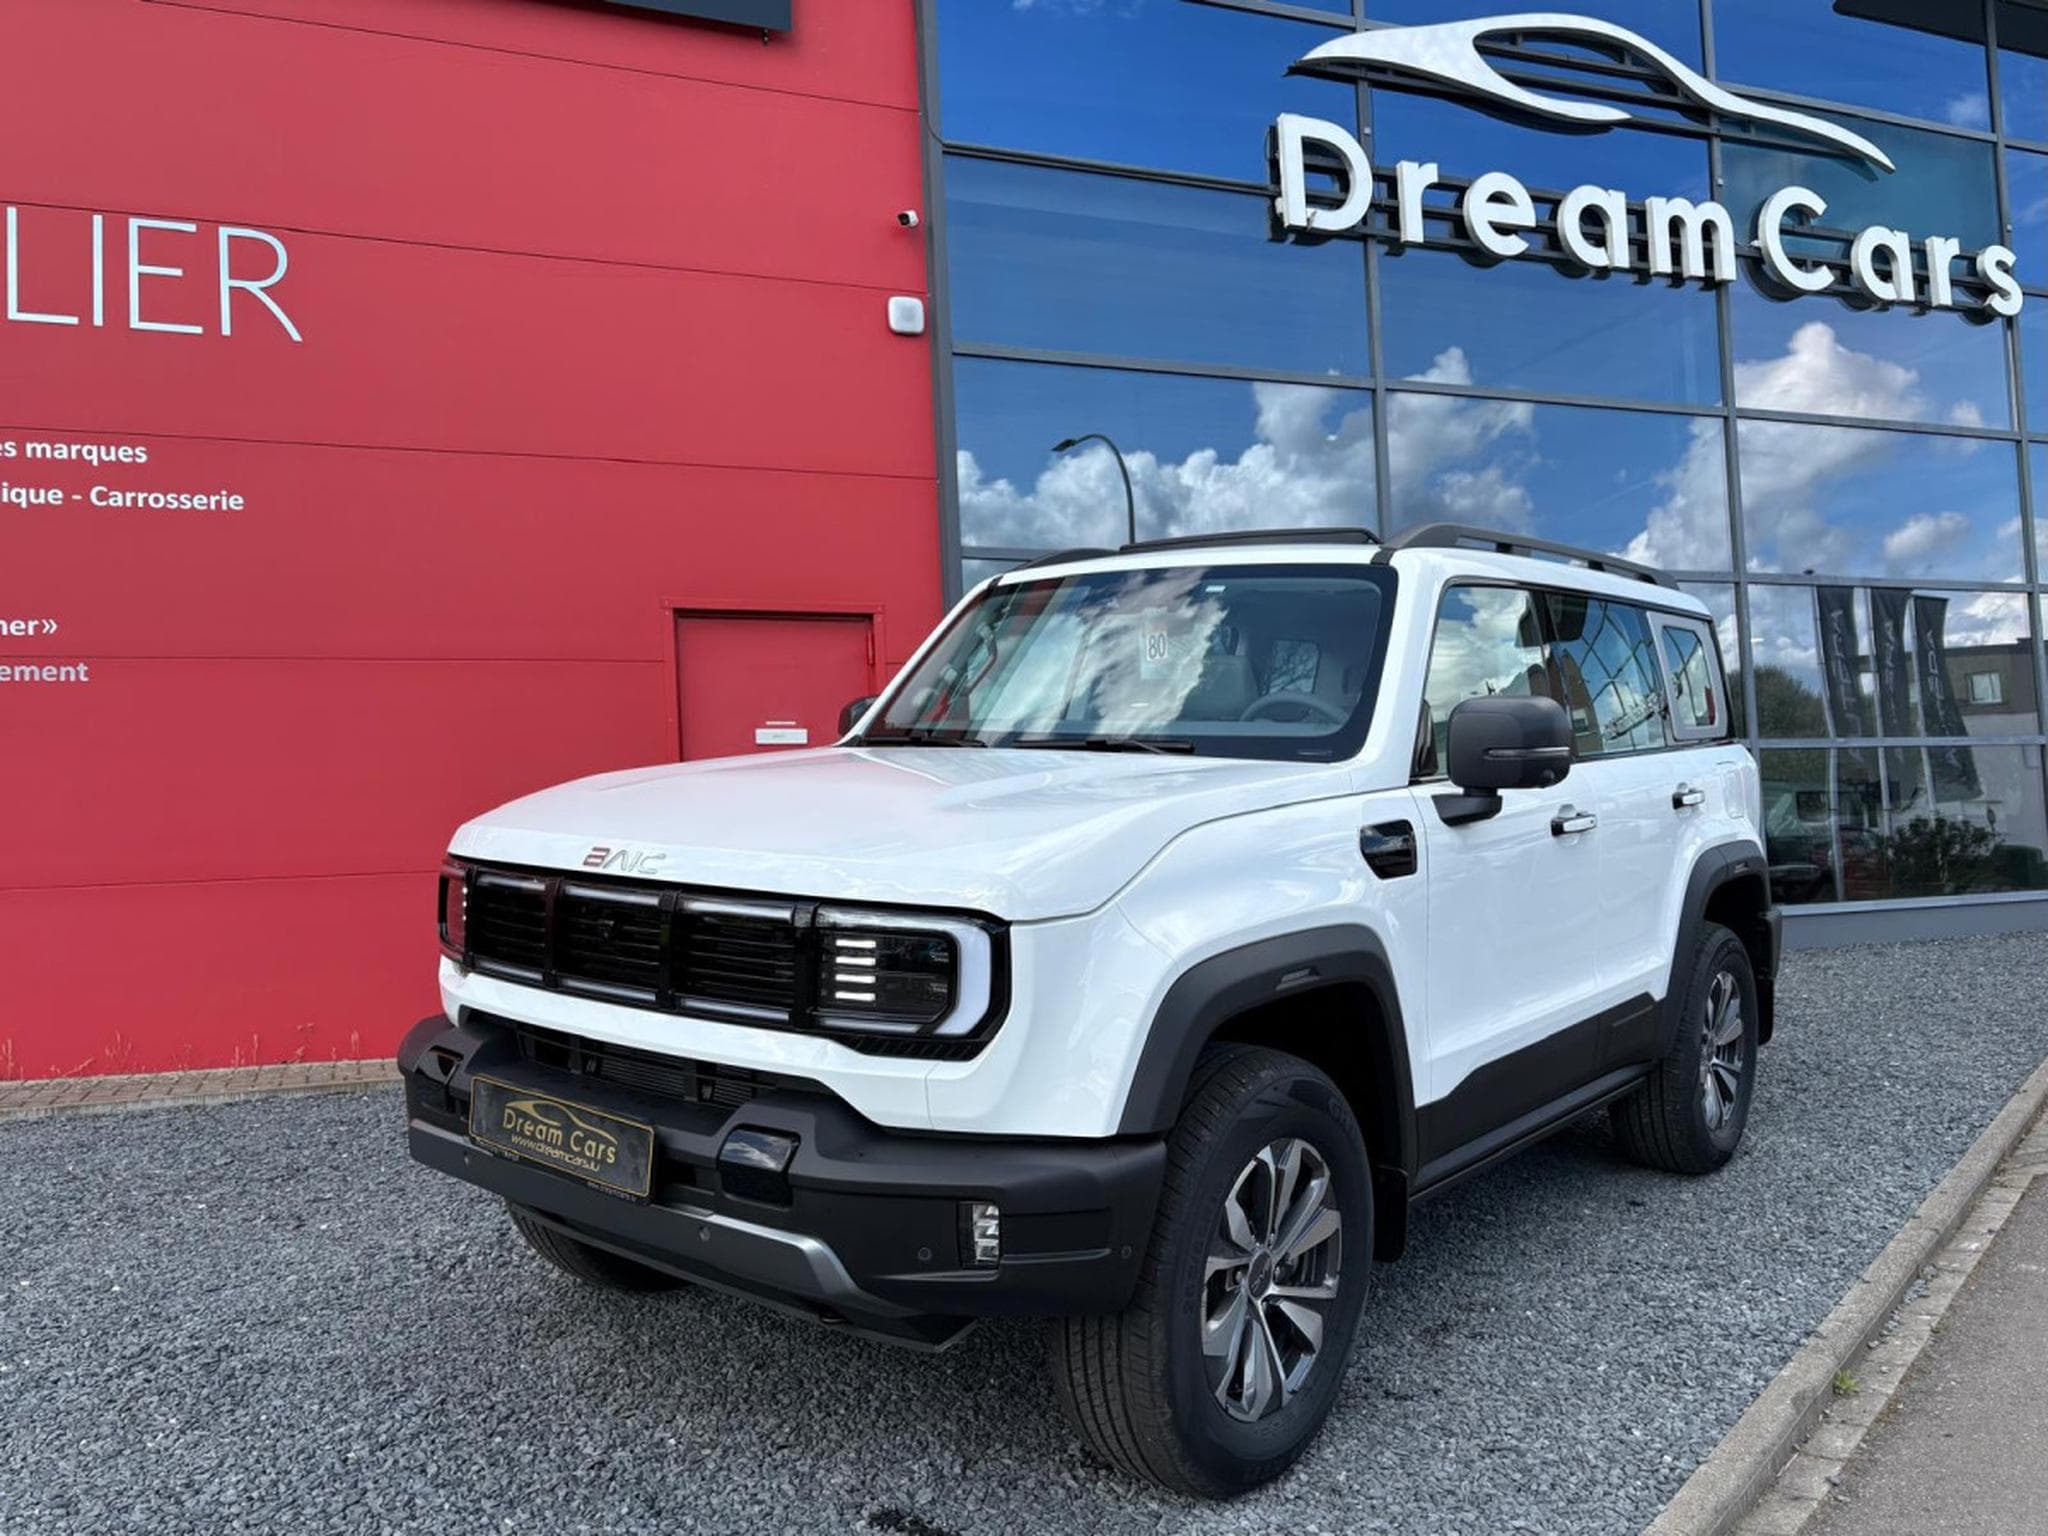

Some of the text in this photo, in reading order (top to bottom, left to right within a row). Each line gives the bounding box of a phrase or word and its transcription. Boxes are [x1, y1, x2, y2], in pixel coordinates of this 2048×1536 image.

[1277, 112, 2024, 317] Dream Cars
[6, 206, 303, 342] LIER
[26, 441, 148, 466] marques
[1, 481, 63, 508] ique
[90, 485, 244, 510] Carrosserie
[1148, 633, 1166, 660] 80
[503, 1108, 616, 1164] Dream Cars
